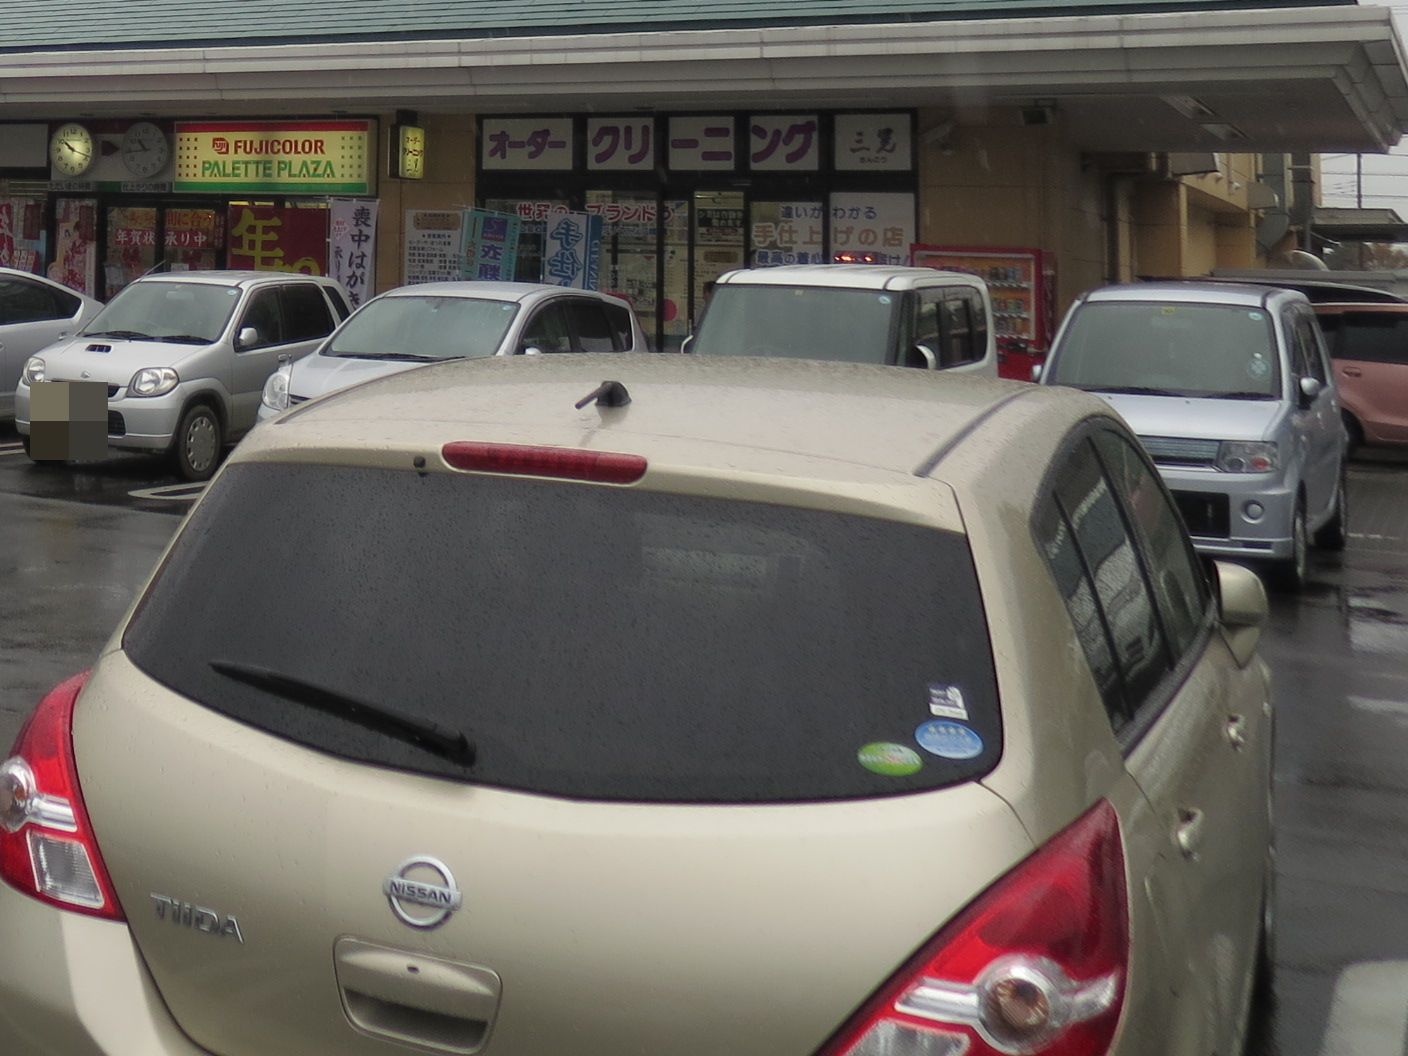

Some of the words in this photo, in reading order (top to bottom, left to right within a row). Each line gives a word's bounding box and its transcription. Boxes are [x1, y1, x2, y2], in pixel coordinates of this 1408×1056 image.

[234, 139, 326, 155] FUJICOLOR
[488, 128, 567, 160] オーダー
[591, 120, 817, 164] クリーニング
[201, 160, 273, 178] PALETTE
[277, 160, 336, 178] PLAZA
[116, 229, 155, 246] 年賀状
[164, 231, 208, 247] 承り中
[753, 224, 905, 247] 手仕上げの店
[390, 879, 452, 903] NISSAN
[150, 891, 245, 945] TIIDA
